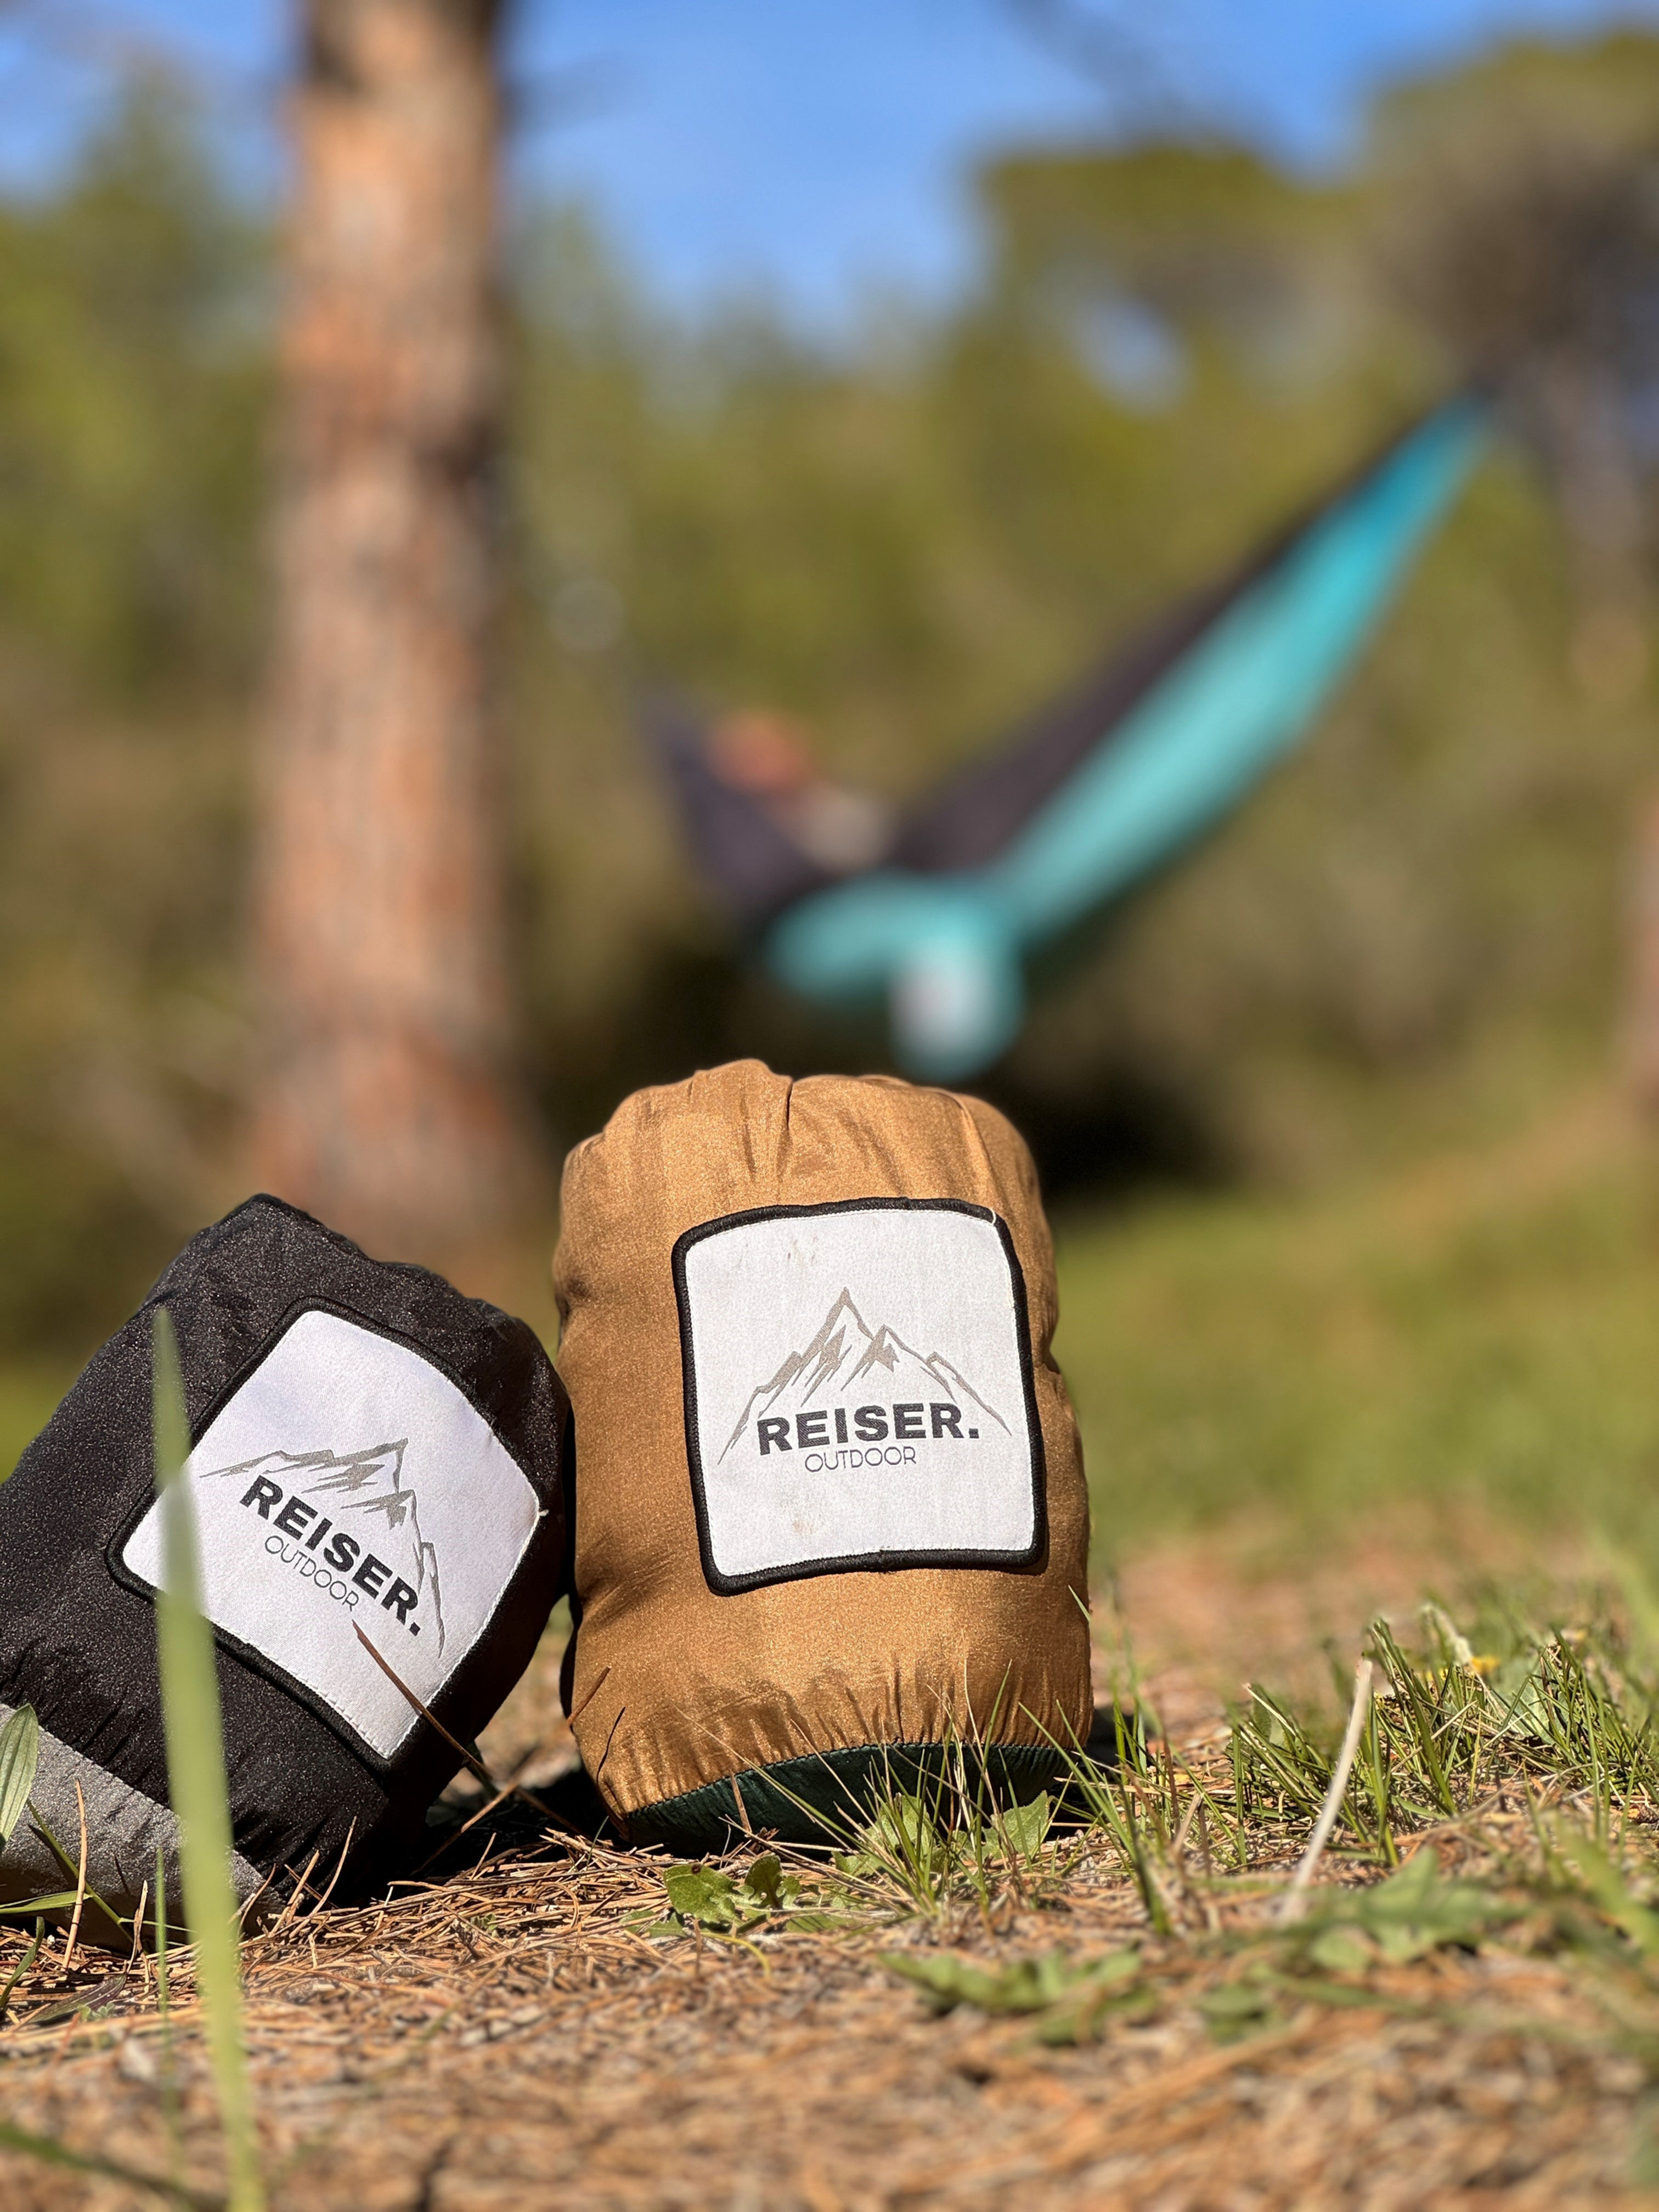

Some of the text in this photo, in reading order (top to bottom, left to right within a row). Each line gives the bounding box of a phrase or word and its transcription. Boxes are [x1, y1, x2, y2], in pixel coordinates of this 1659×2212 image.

[757, 1402, 980, 1455] REISER.
[804, 1446, 917, 1472] OUTDOOR
[239, 1475, 421, 1637] REISER.
[264, 1536, 360, 1612] OUTDOOR
